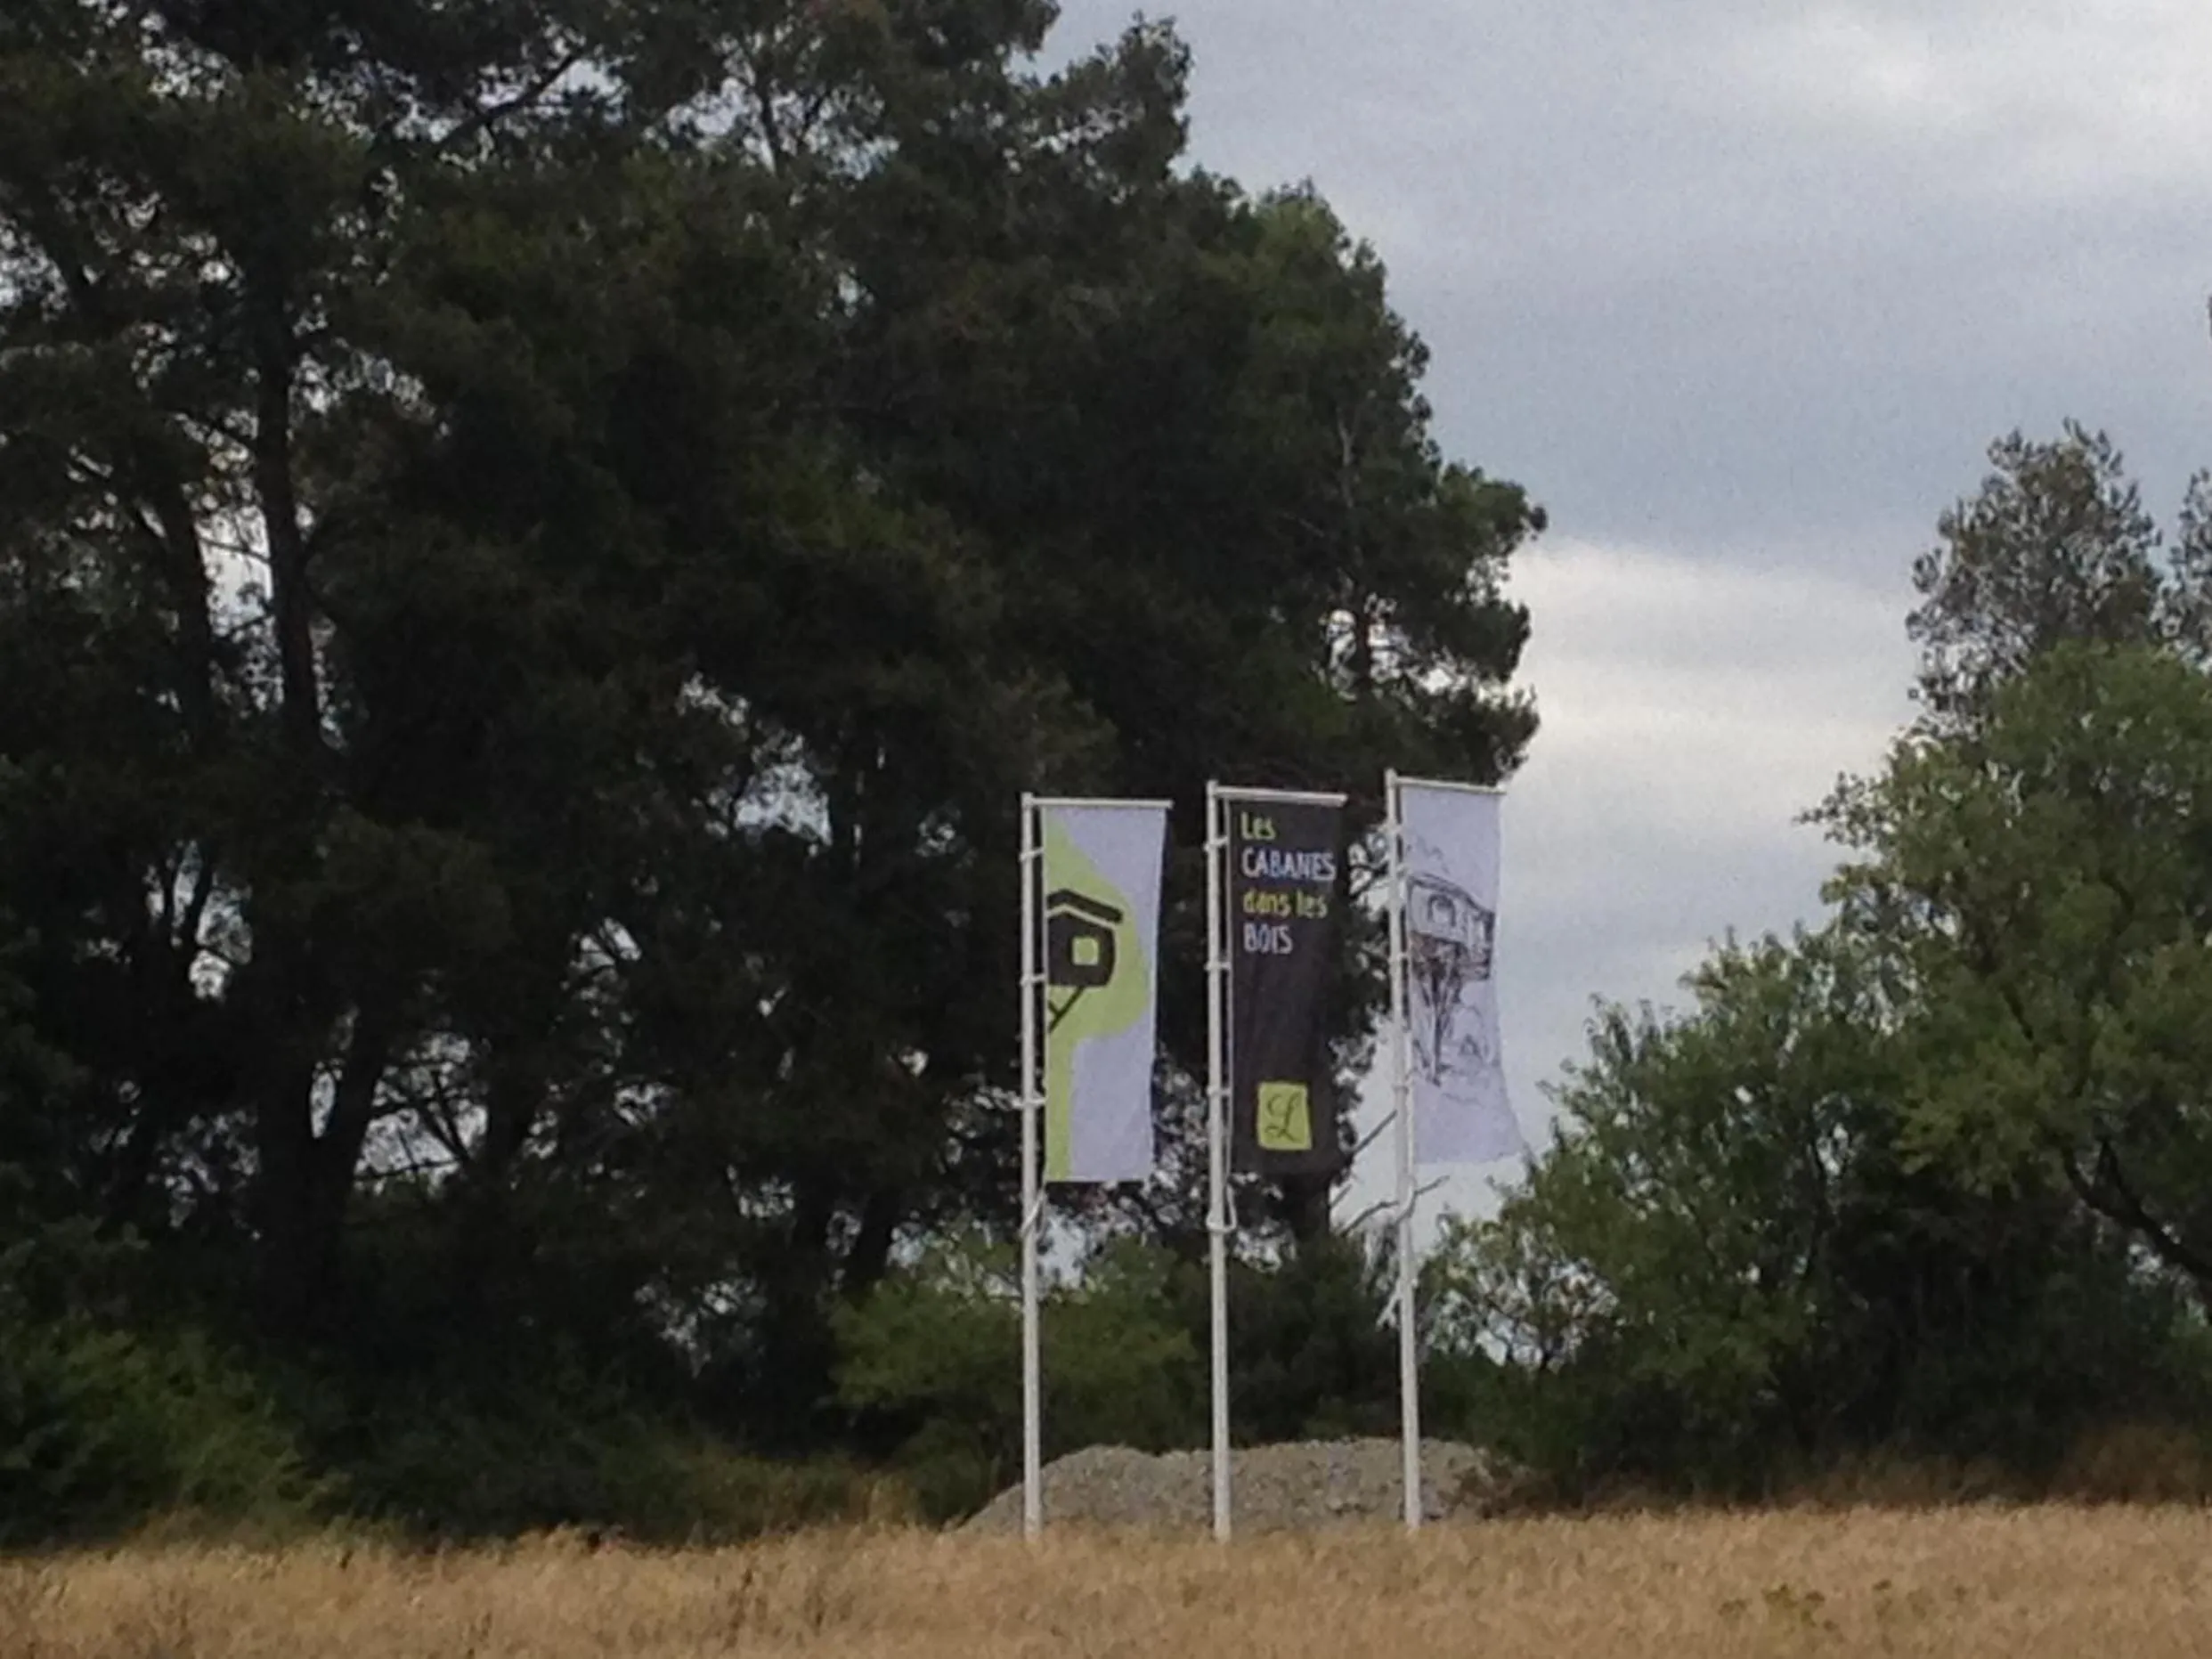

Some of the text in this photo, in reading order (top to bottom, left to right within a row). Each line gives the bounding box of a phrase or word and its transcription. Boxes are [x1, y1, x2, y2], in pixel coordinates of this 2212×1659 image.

[1241, 847, 1336, 881] CABANES
[1243, 888, 1291, 917] dans
[1243, 922, 1293, 955] BOIS
